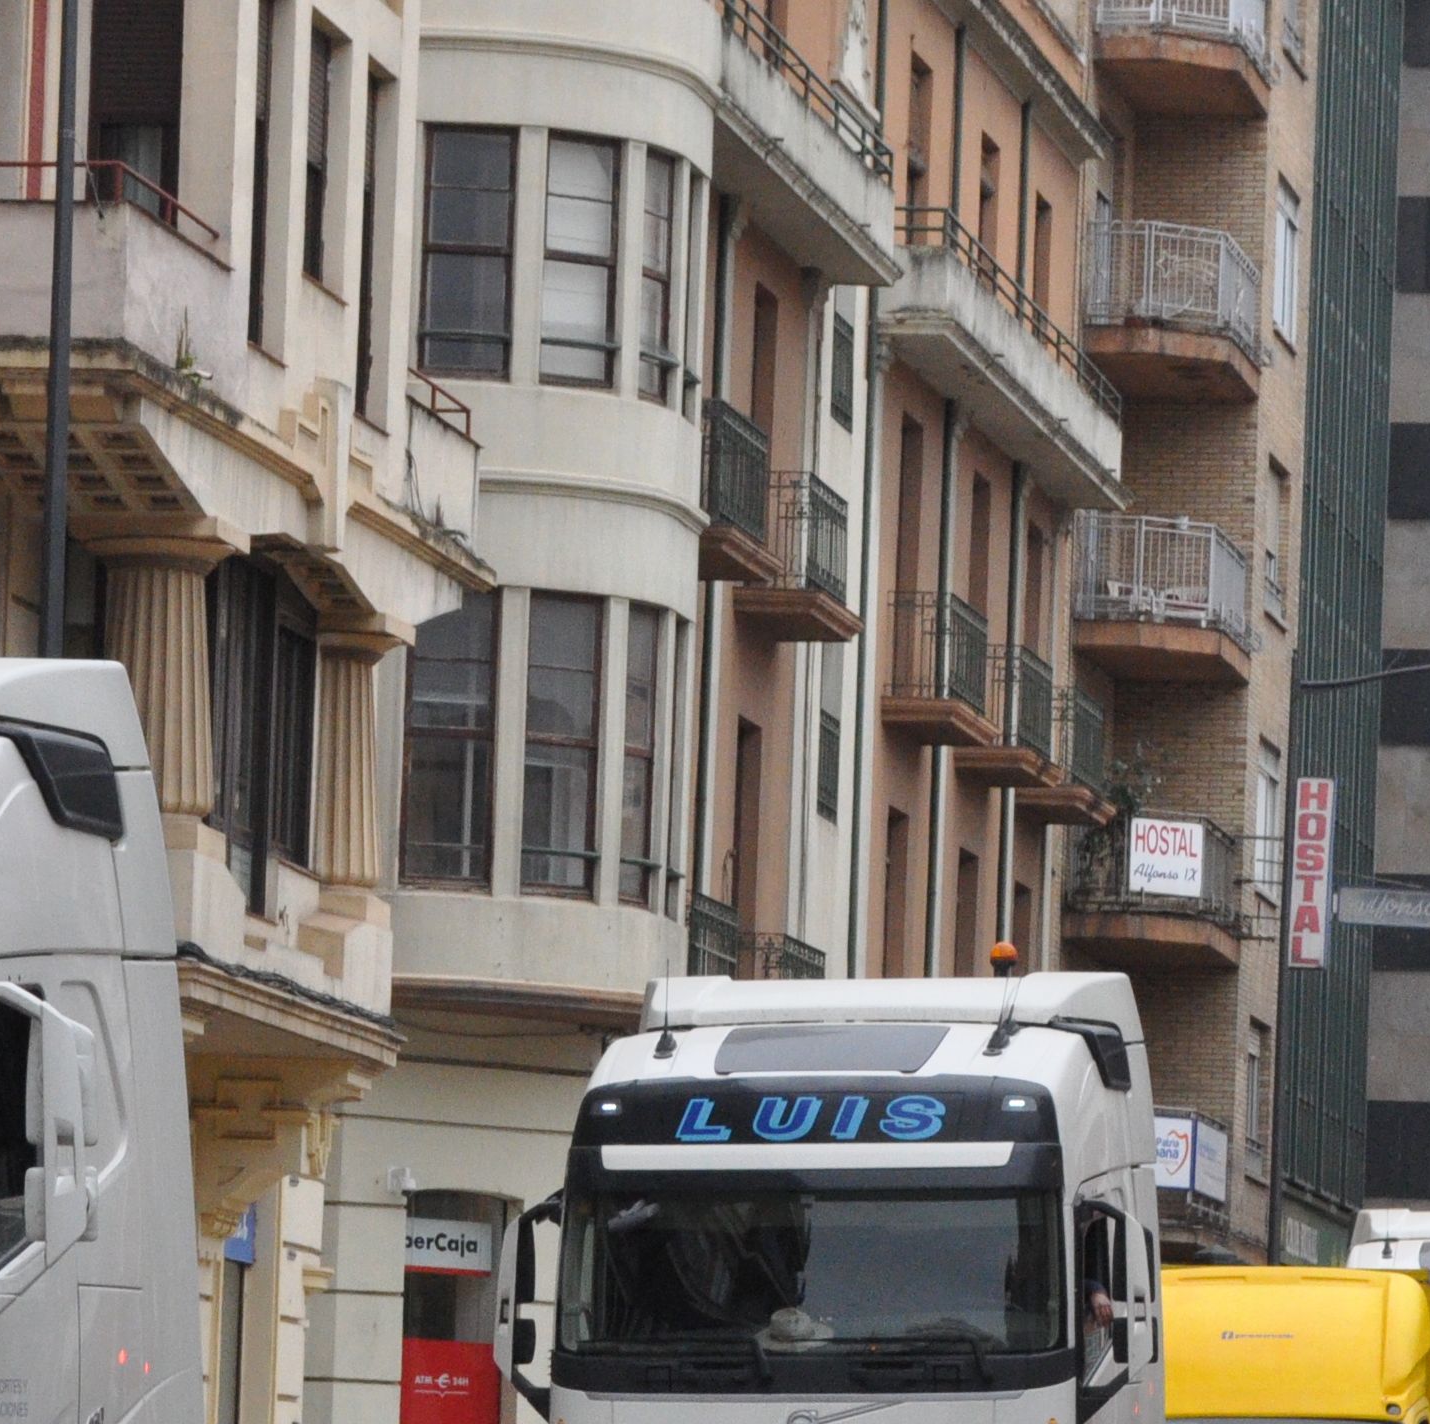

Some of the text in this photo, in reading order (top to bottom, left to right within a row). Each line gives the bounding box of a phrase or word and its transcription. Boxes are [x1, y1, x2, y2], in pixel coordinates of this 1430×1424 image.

[1135, 823, 1197, 857] HOSTAL
[1134, 863, 1179, 882] Alfonso
[1290, 781, 1329, 966] HOSTAL
[676, 1094, 947, 1141] LUIS
